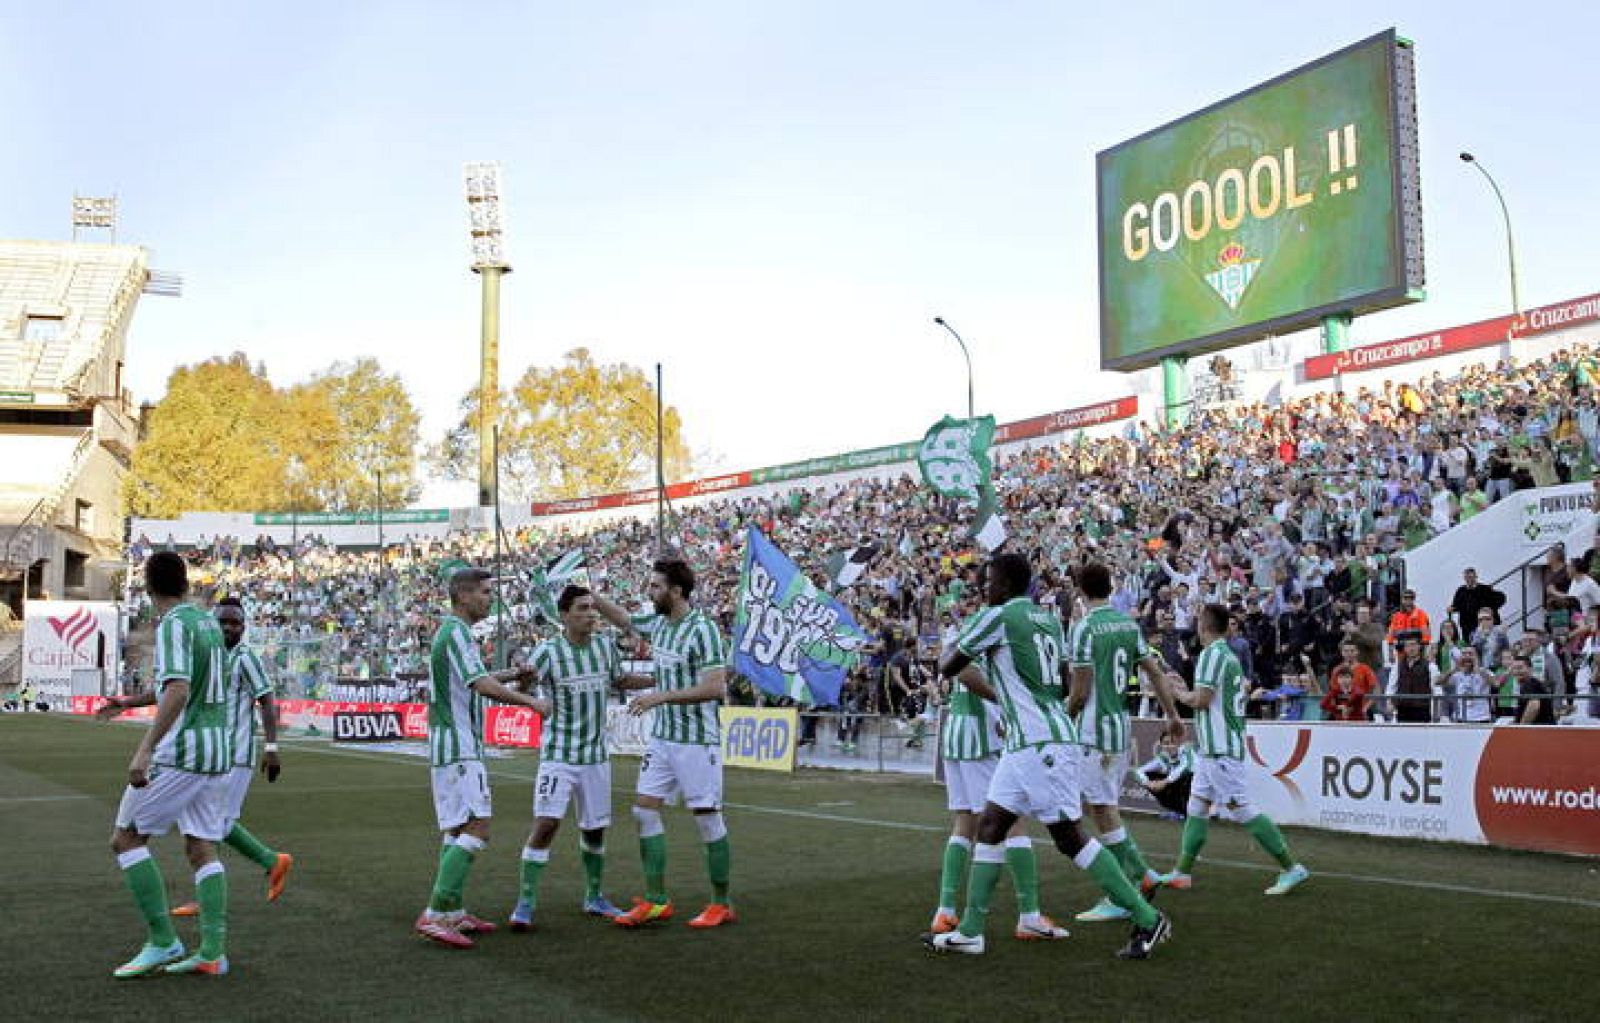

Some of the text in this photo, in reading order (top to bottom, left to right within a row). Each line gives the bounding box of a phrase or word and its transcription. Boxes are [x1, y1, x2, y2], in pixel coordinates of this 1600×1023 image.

[1121, 146, 1314, 262] GOOOOL
[1352, 337, 1430, 366] Cruzcampo
[1113, 647, 1128, 695] 6
[338, 715, 402, 738] BBVA
[727, 715, 790, 762] ABAD
[539, 773, 558, 796] 21
[1321, 755, 1443, 804] ROYSE
[1492, 786, 1600, 810] www.rod
